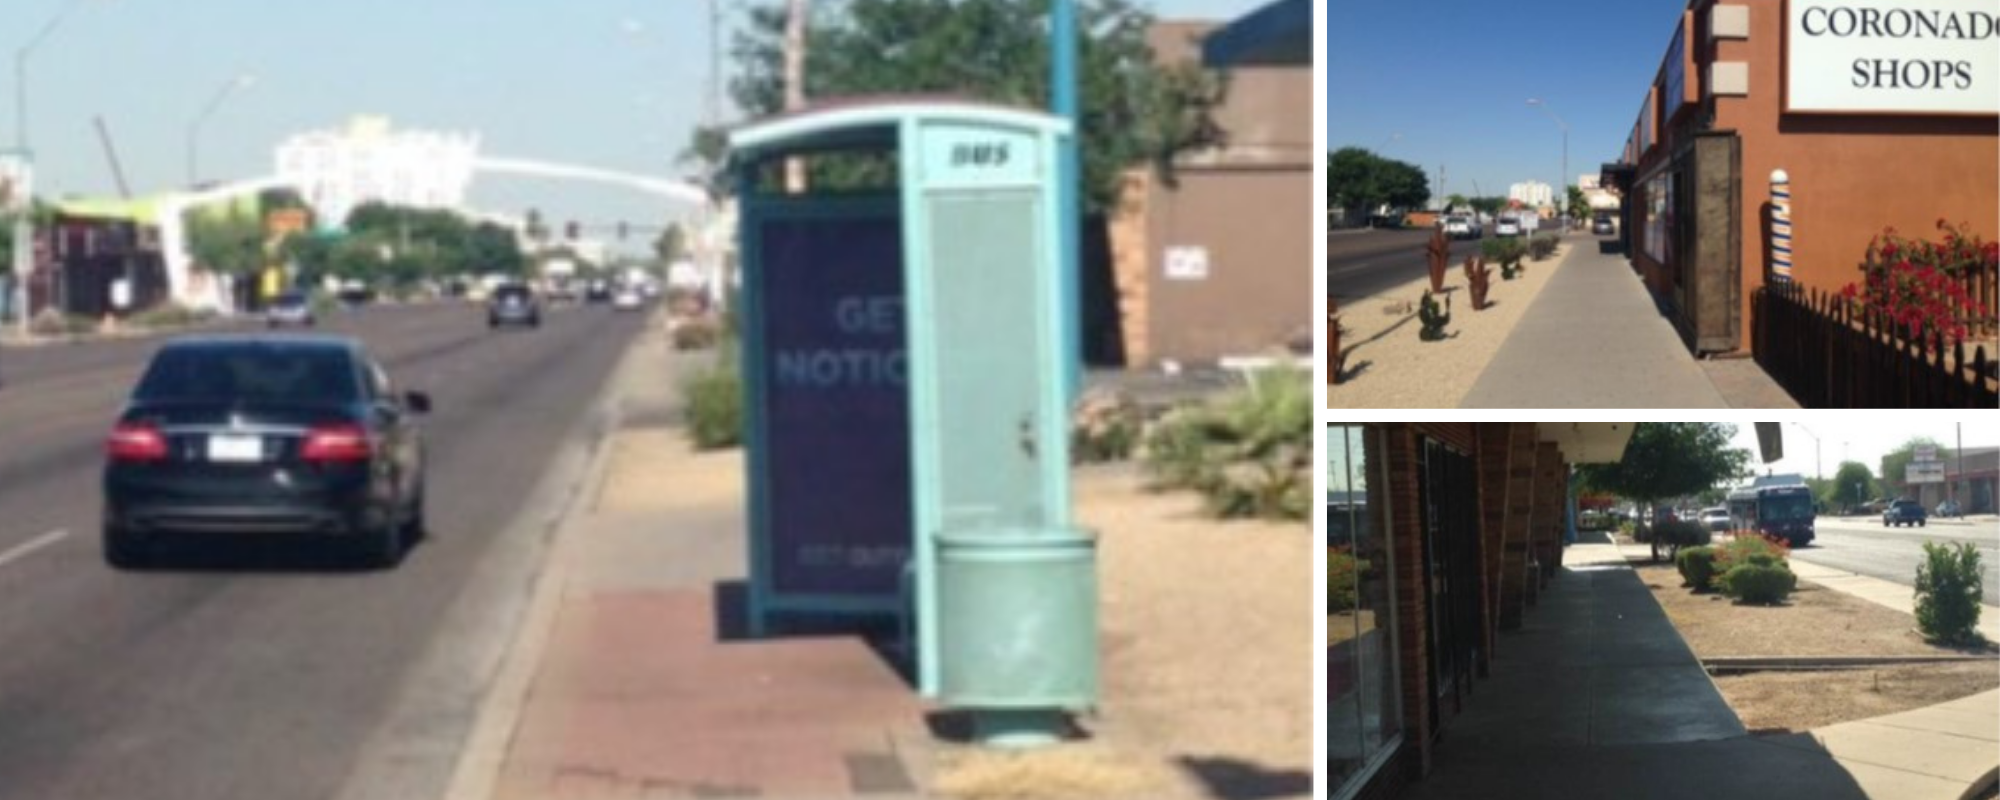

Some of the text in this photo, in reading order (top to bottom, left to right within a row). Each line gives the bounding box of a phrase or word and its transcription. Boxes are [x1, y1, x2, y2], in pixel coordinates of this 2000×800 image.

[1801, 6, 1999, 40] CORONAD
[1851, 57, 1972, 90] SHOPS
[949, 140, 1010, 169] BUS
